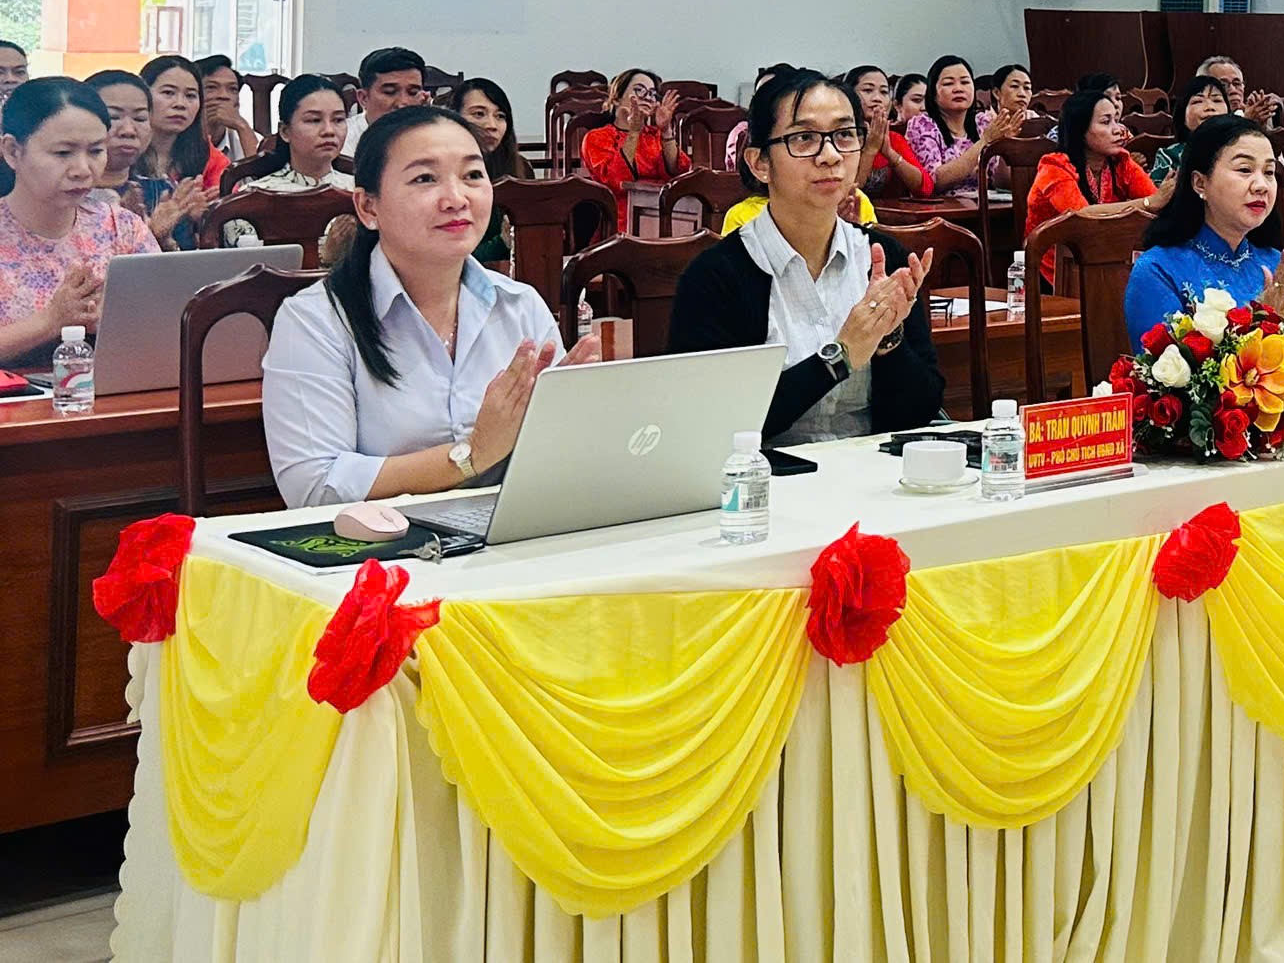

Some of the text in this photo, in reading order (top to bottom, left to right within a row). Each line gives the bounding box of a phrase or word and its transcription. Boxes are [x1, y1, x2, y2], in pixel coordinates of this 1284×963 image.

[628, 424, 661, 456] hp
[1029, 406, 1126, 443] BÀ: TRẦN QUỲNH TRÂM
